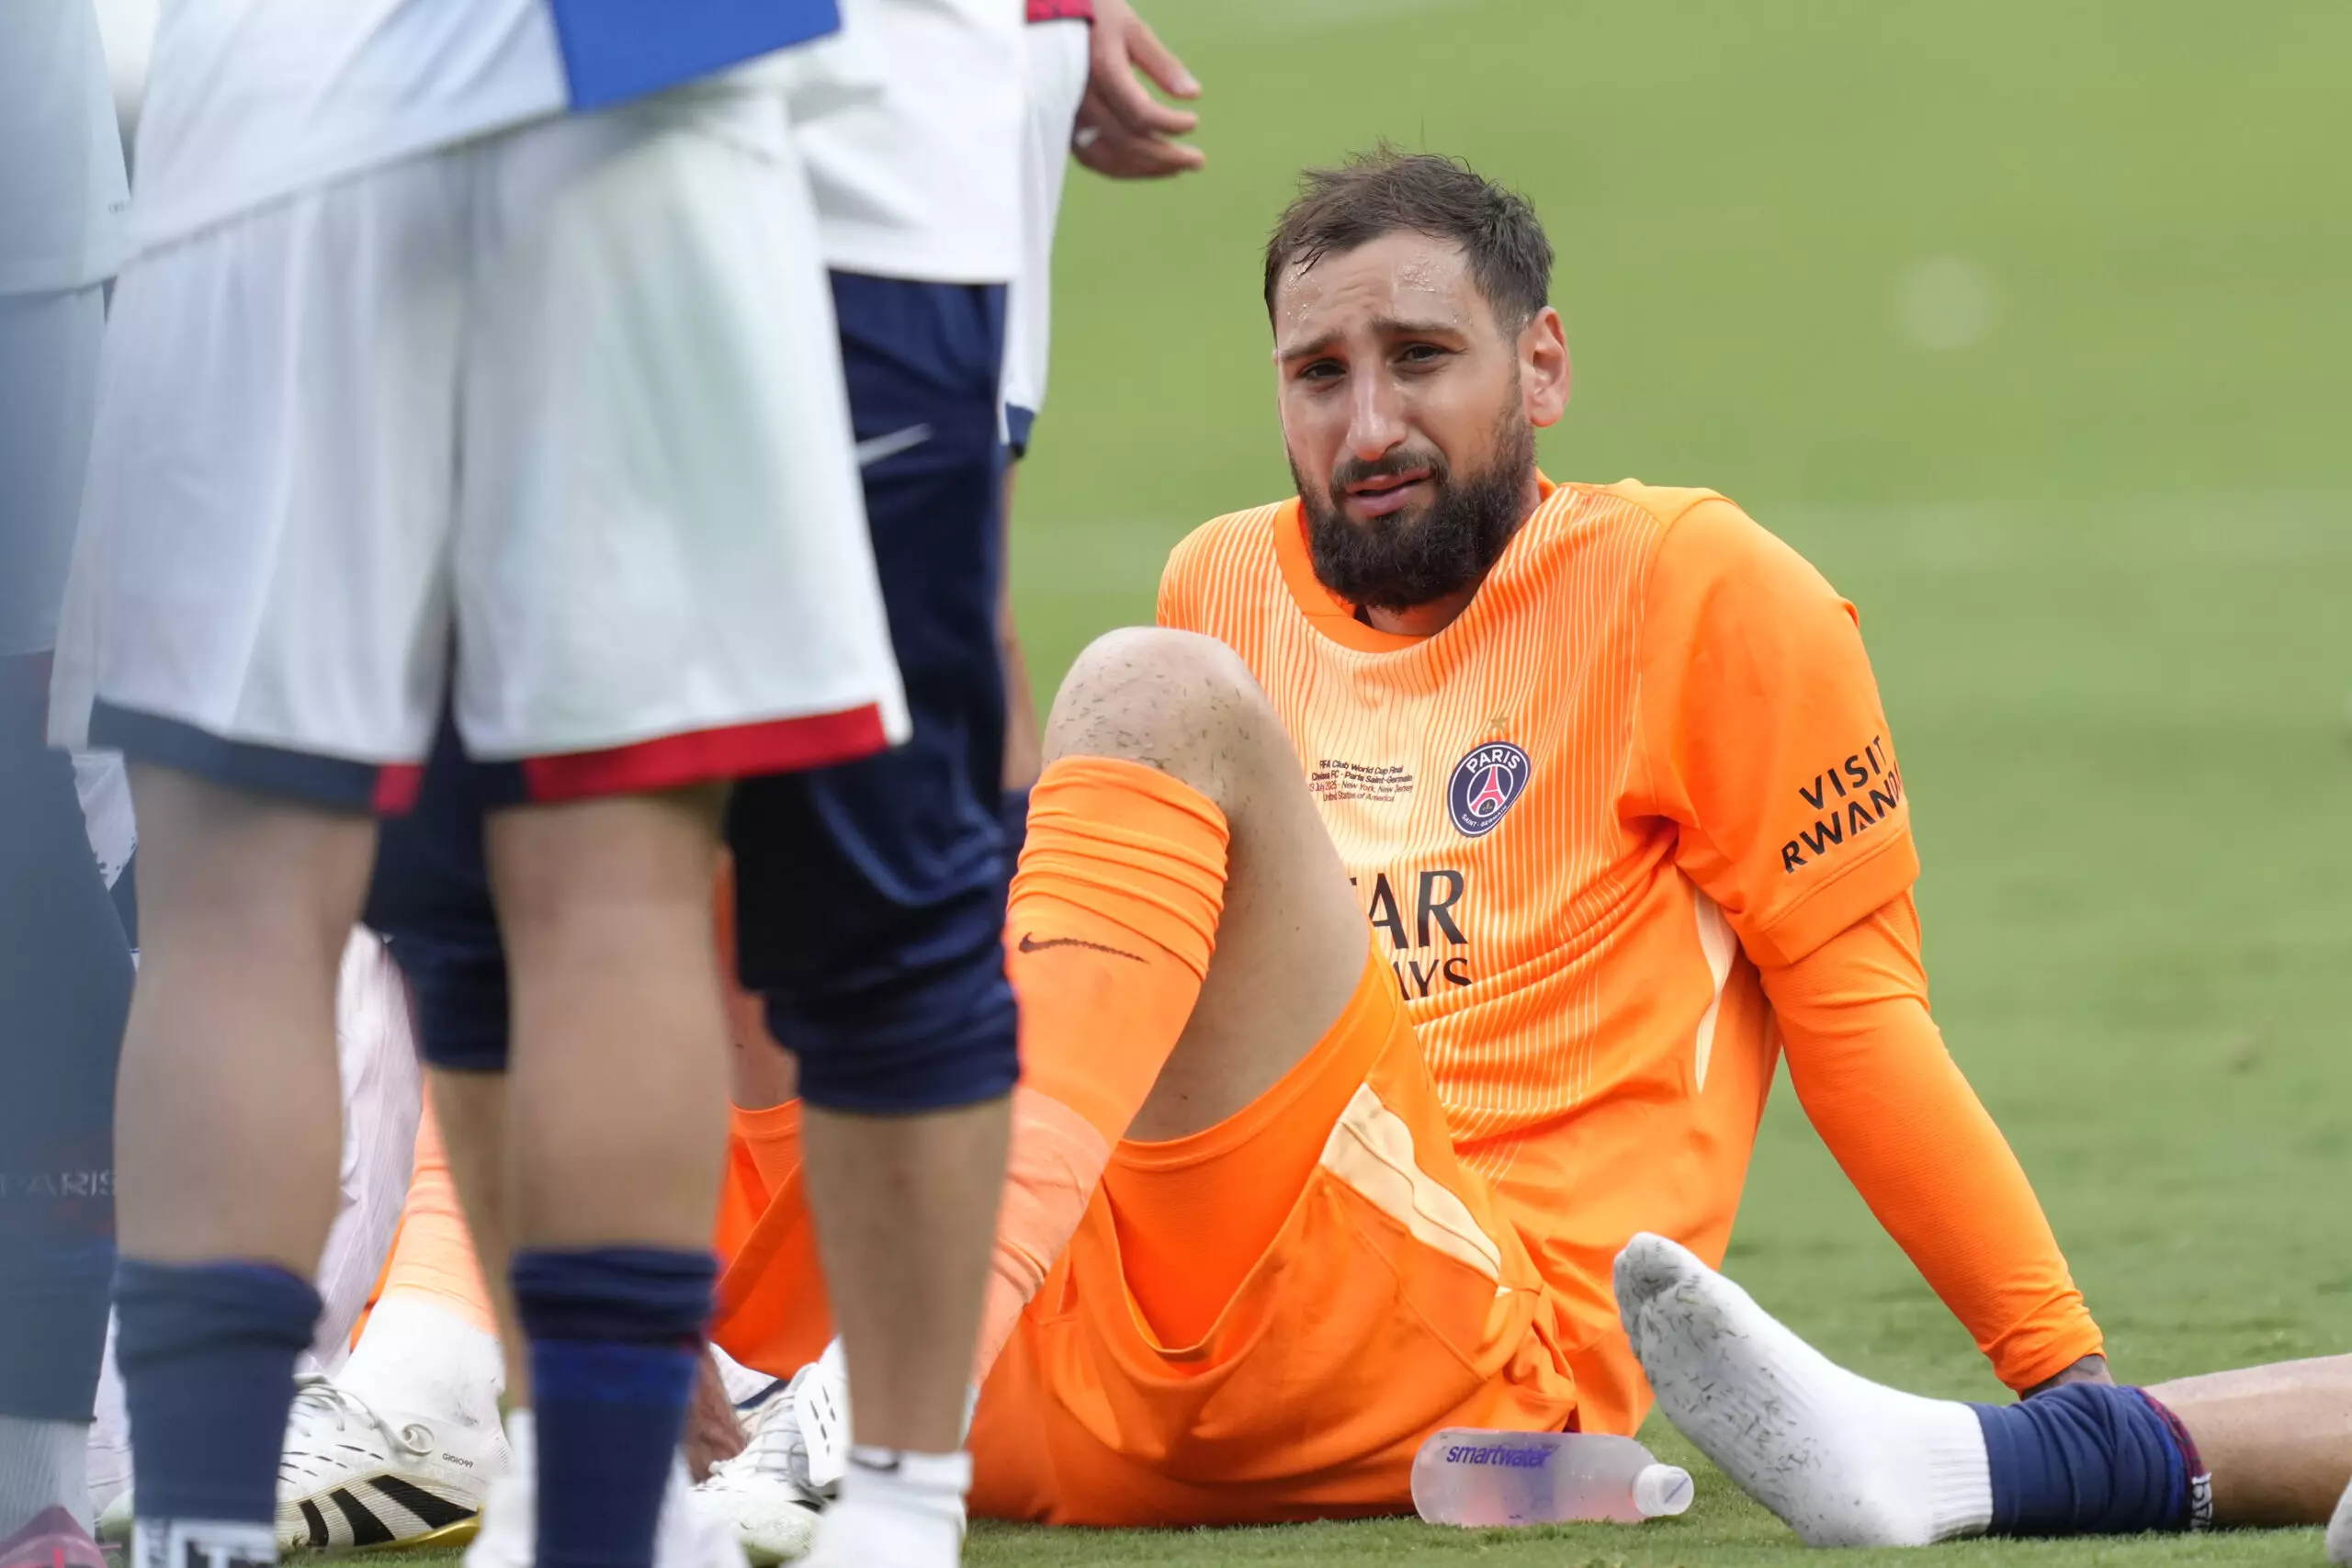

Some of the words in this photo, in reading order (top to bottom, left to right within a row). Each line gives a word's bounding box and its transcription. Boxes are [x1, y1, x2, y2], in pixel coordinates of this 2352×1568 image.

[1332, 760, 1349, 769] Club
[1351, 763, 1374, 773] World
[1374, 767, 1388, 775] Cup
[1465, 749, 1521, 773] PARIS
[1331, 770, 1340, 778] FC
[1345, 772, 1364, 781] Paris
[1798, 735, 1886, 810] VISIT
[1341, 781, 1357, 789] New
[1395, 784, 1413, 793] Jersey
[1338, 791, 1355, 800] States
[1366, 794, 1395, 802] America
[1446, 1445, 1553, 1468] smartwater
